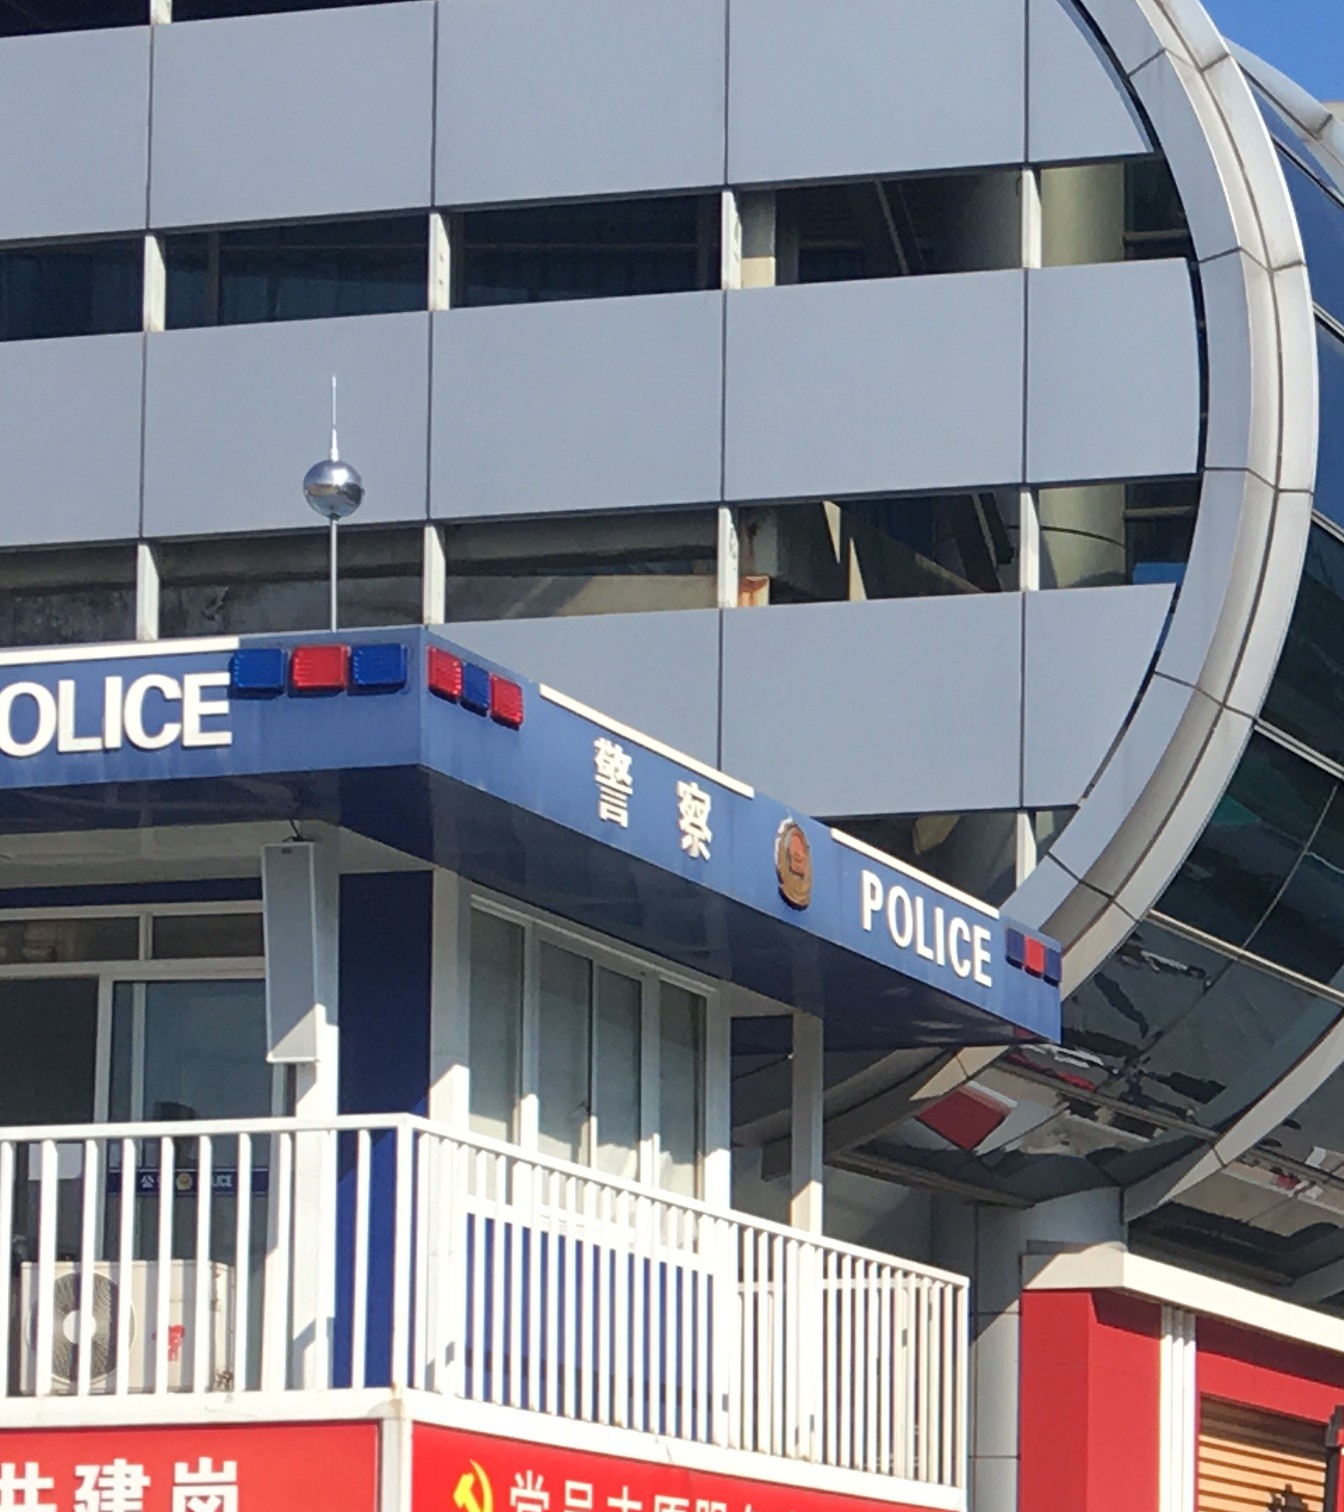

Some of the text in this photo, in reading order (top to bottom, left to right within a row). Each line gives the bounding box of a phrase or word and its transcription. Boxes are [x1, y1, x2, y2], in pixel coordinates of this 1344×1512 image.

[0, 672, 233, 757] OLICE
[592, 737, 714, 860] 警察
[858, 867, 994, 990] POLICE
